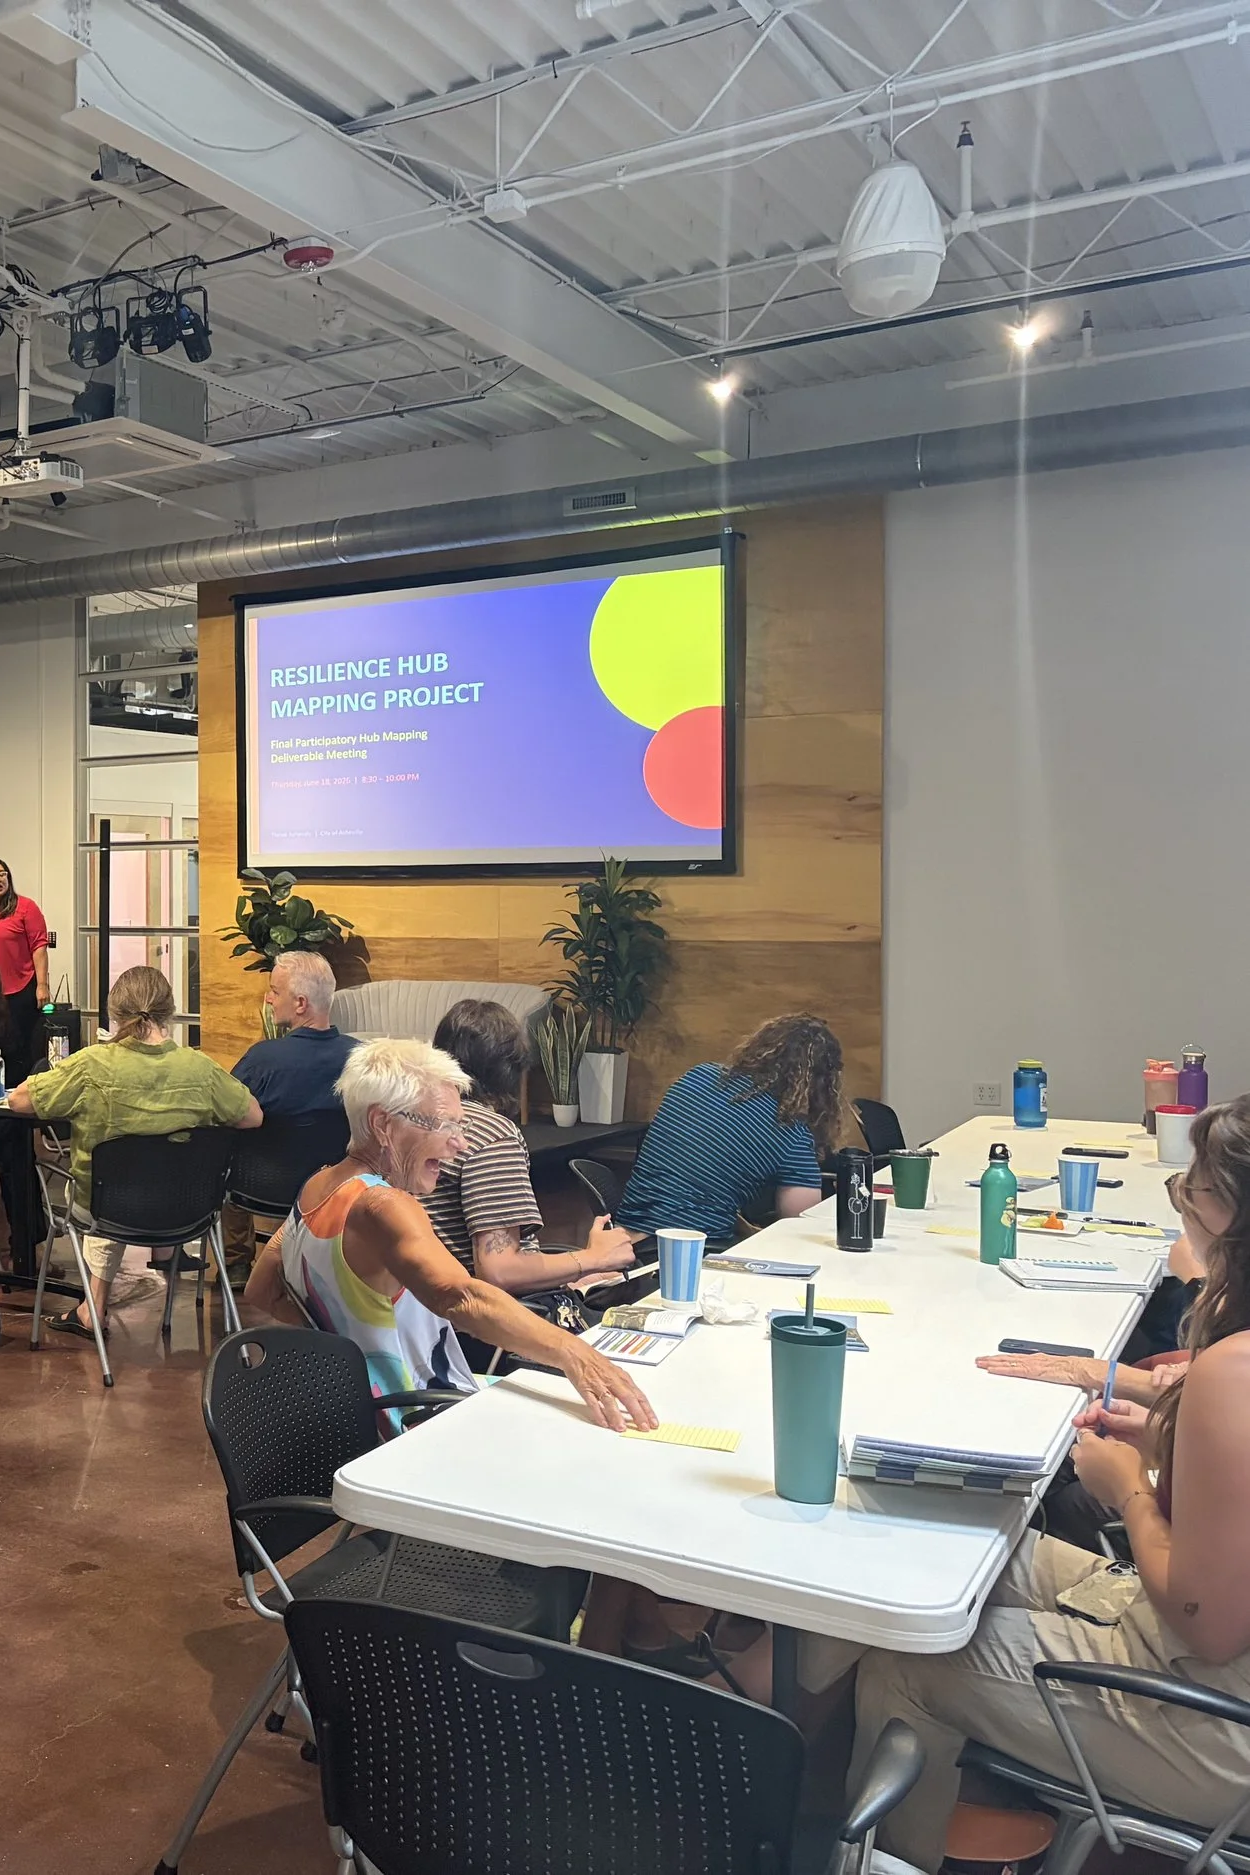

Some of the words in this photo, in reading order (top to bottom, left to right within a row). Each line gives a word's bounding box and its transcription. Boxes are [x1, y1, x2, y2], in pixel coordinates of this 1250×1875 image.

[271, 658, 391, 688] RESILIENCE
[398, 652, 449, 676] HUB
[271, 691, 377, 719] MAPPING
[384, 682, 485, 709] PROJECT
[270, 739, 293, 750] Final
[295, 734, 357, 748] Participatory
[359, 731, 380, 743] Hub
[383, 730, 428, 742] Mapping
[270, 750, 324, 764] Deliverable
[326, 748, 368, 760] Meeting
[407, 772, 420, 781] PM
